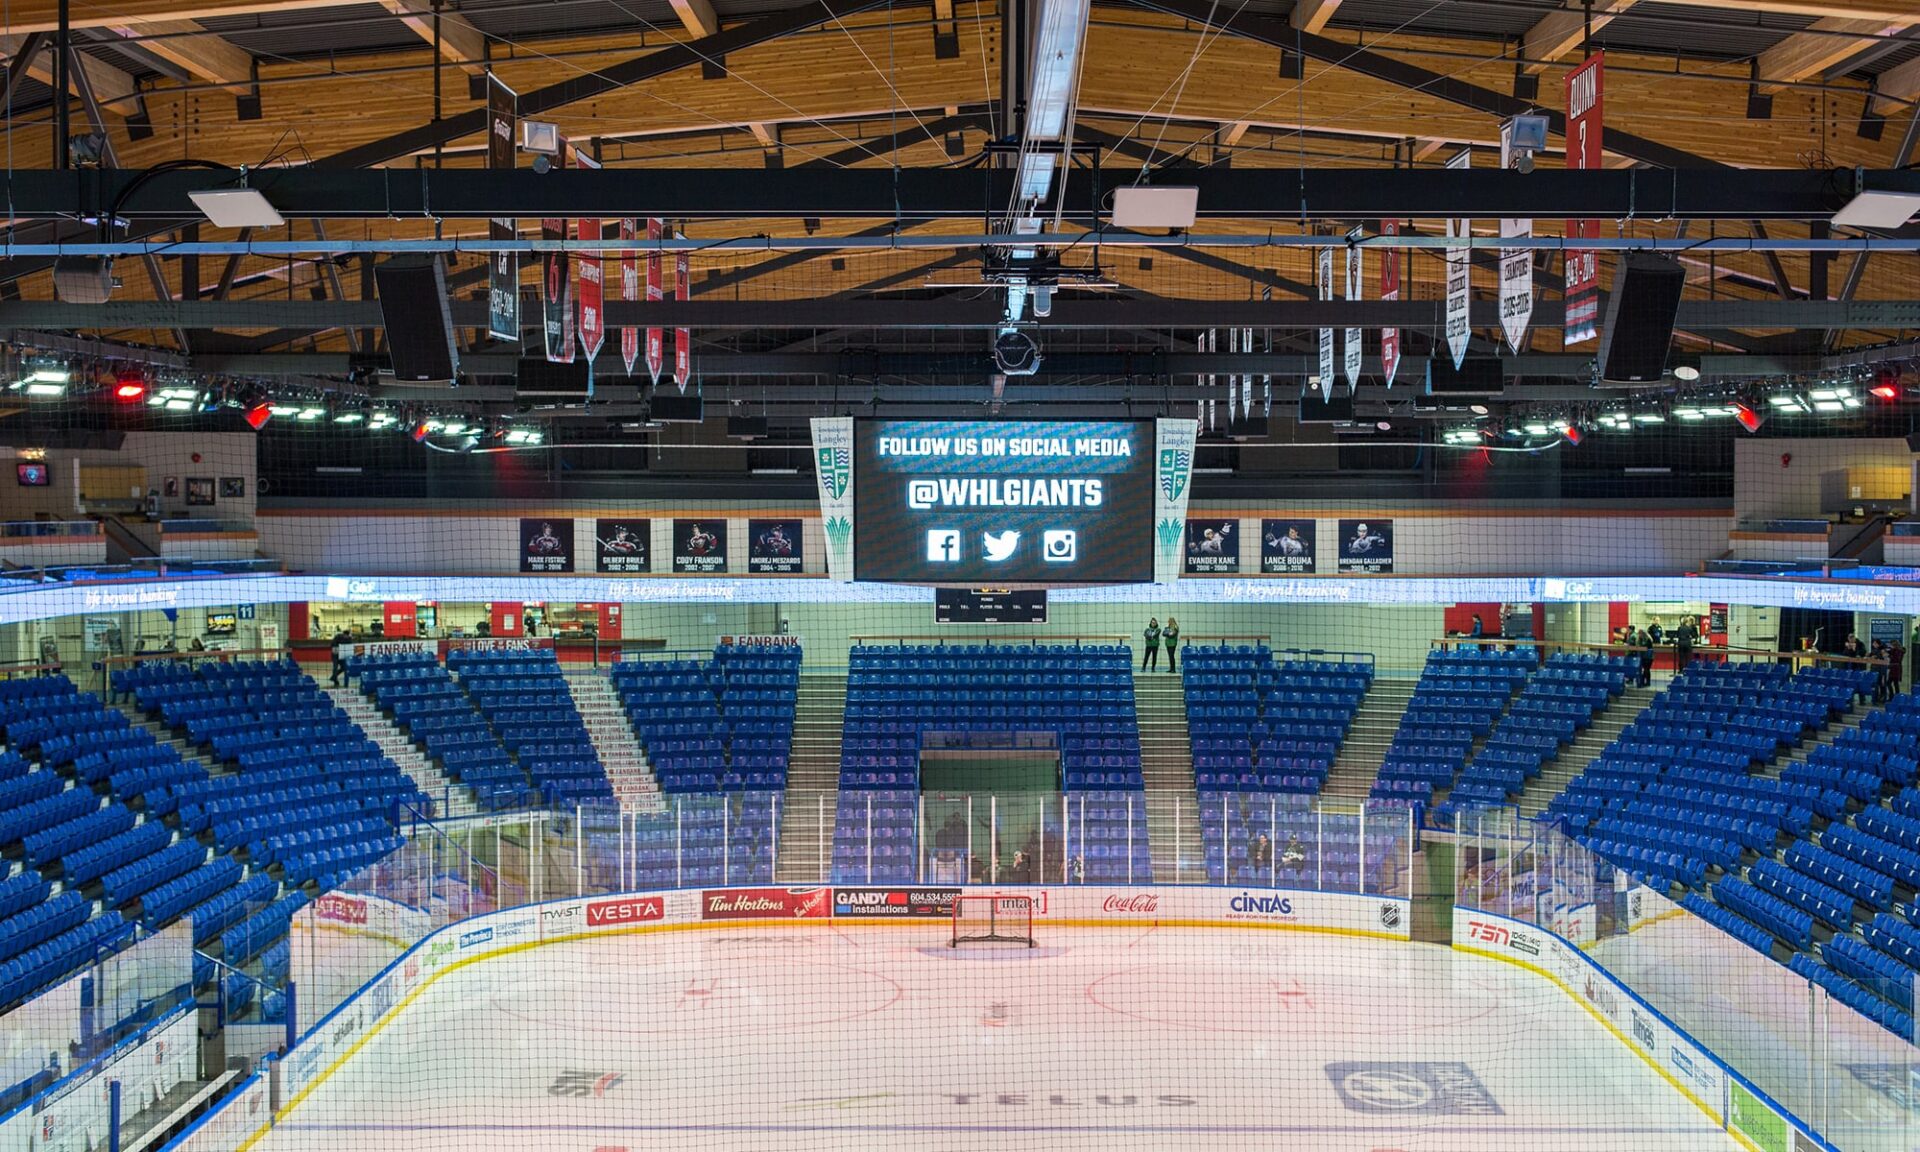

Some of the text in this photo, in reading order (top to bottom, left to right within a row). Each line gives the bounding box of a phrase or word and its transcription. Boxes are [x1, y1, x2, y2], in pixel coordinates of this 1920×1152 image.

[1571, 63, 1597, 120] QUINN
[818, 434, 847, 446] Langley
[880, 438, 1131, 457] FOLLOW US ON SOCIAL MEDIA
[1162, 435, 1189, 447] Langley
[909, 478, 1102, 509] @WHLGIANTS
[1189, 557, 1235, 565] EVANDER KANE
[1265, 557, 1312, 565] LANCE BOUMA
[86, 587, 177, 608] life beyond banking
[609, 581, 736, 599] life beyond banking
[1223, 581, 1348, 599] life beyond banking
[1794, 586, 1886, 609] life beyond banking
[240, 607, 253, 618] 11
[371, 642, 424, 656] FANBANK
[472, 640, 495, 651] LOVE
[506, 640, 529, 651] FANS
[739, 636, 799, 647] FANBANK
[709, 895, 733, 912] Tim
[734, 895, 783, 911] Hortons
[837, 892, 888, 905] GANDY
[1002, 897, 1040, 909] intact
[1103, 894, 1160, 913] Coca-Cola
[540, 906, 582, 921] TWIST
[591, 902, 658, 921] VESTA
[1469, 921, 1509, 946] TSN
[1631, 1008, 1655, 1050] Times
[944, 1093, 1198, 1107] TELUS
